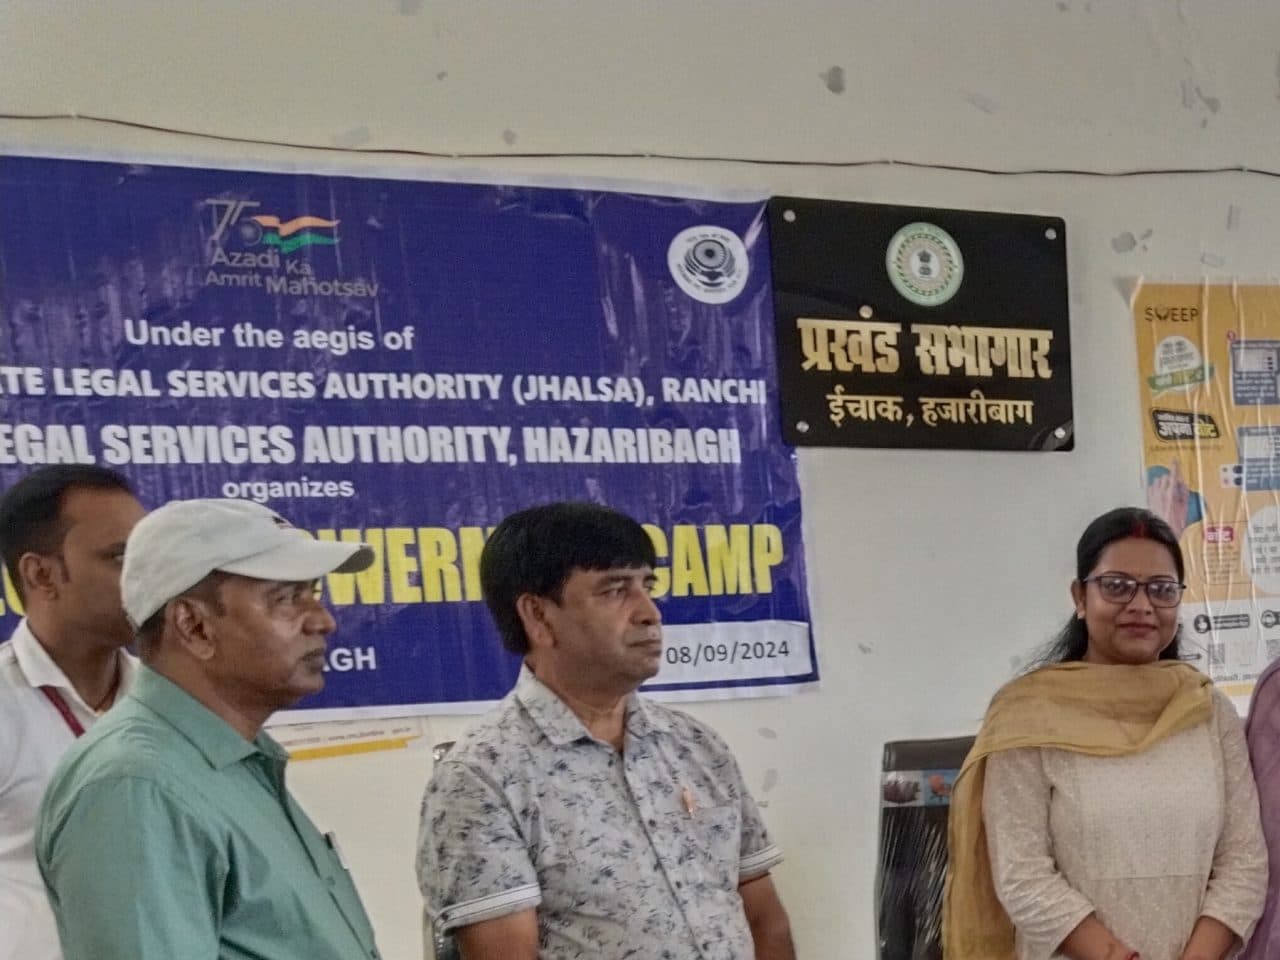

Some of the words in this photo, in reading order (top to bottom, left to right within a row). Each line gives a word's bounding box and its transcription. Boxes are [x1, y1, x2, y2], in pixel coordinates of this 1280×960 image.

[211, 248, 280, 268] Azadi
[286, 259, 312, 275] Ka
[205, 270, 262, 287] Amrit
[265, 276, 379, 297] Mahotsav
[1144, 307, 1199, 322] SWEEP
[125, 319, 225, 347] Under
[232, 323, 284, 348] the
[293, 325, 376, 355] aegis
[384, 326, 415, 350] of
[797, 318, 901, 373] प्रखंड
[911, 323, 1053, 378] सभागार
[0, 366, 46, 396] TE
[55, 368, 160, 397] LEGAL
[167, 370, 316, 399] SERVICES
[323, 372, 503, 400] AUTHORITY
[513, 374, 655, 407] (JHALSA),
[661, 377, 767, 404] RANCHI
[918, 389, 1034, 425] हजारीबाग
[101, 425, 296, 464] SERVICES
[303, 424, 517, 466] AUTHORITY,
[522, 426, 742, 463] HAZARIBAGH
[222, 477, 355, 503] organizes
[641, 523, 784, 599] CAMP
[323, 646, 377, 672] GH
[665, 640, 790, 667] 08/09/2024
